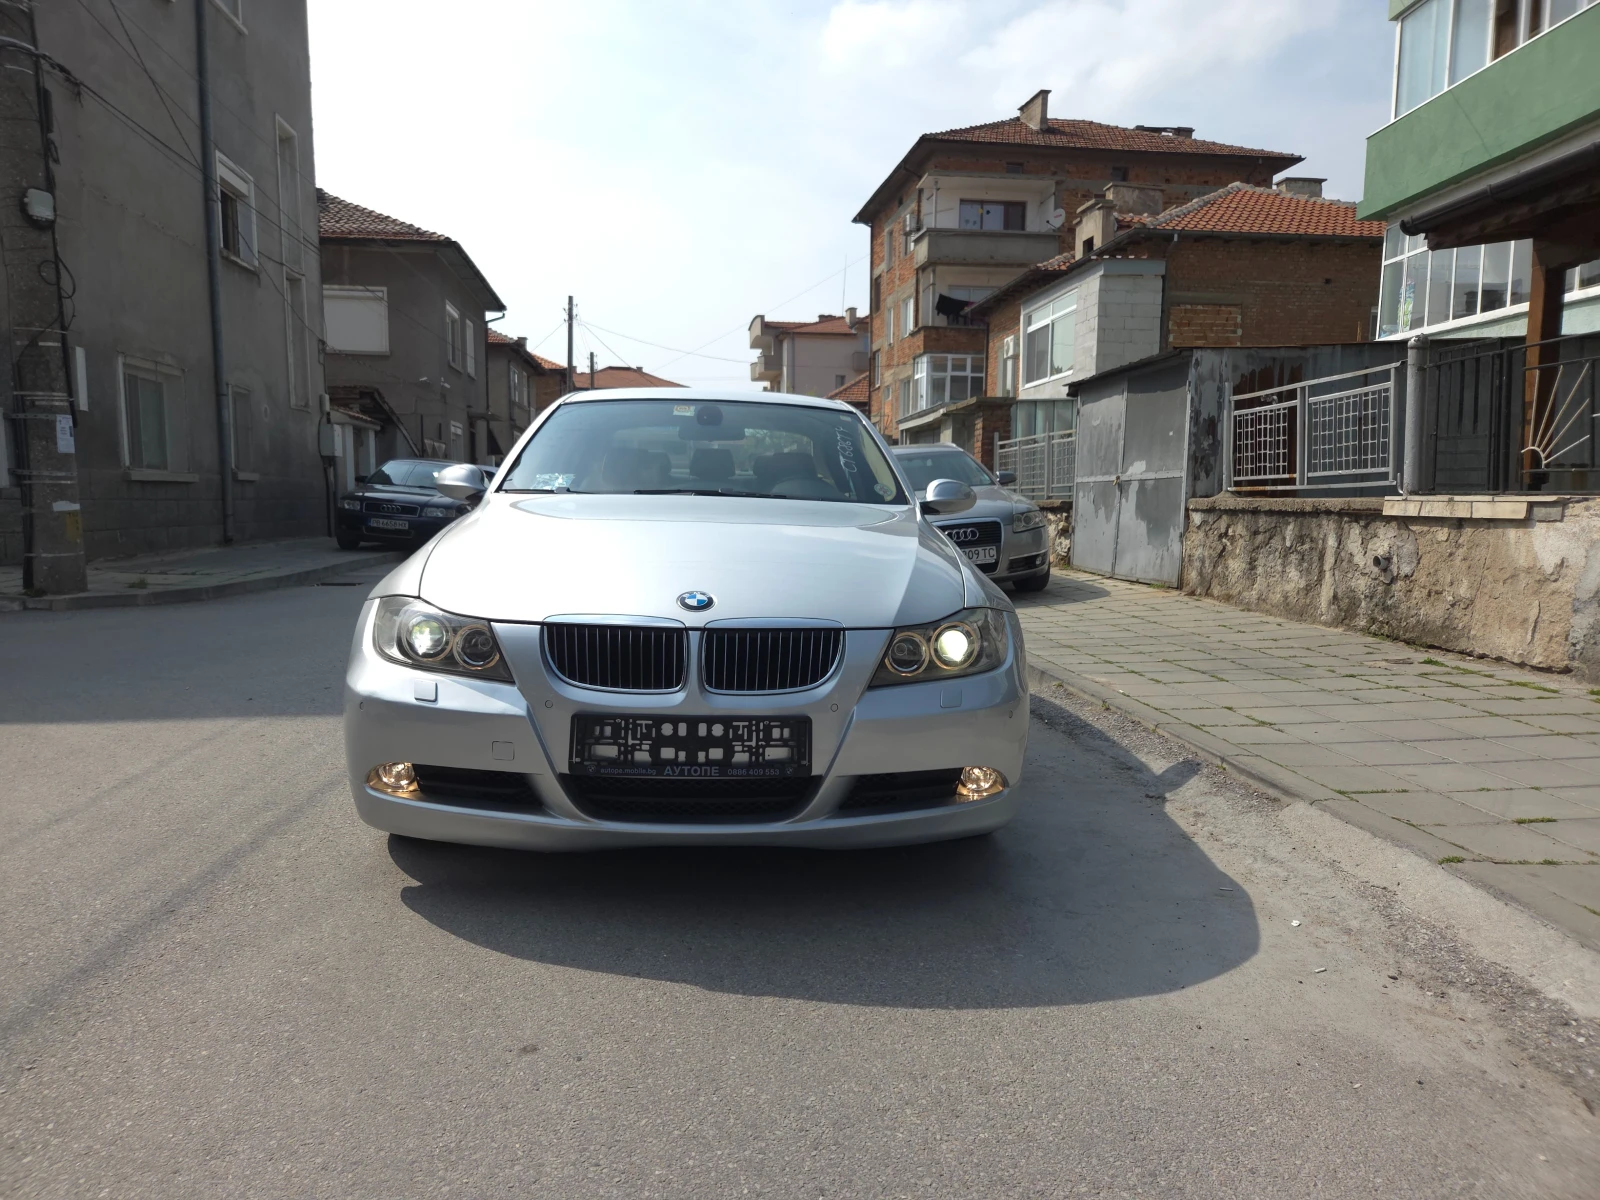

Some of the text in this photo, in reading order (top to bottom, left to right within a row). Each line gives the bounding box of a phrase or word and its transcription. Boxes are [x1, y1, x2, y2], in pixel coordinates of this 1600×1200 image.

[981, 547, 995, 559] TC
[600, 767, 657, 775] autope.mobile.bg
[663, 766, 719, 776] АУТОПЕ
[727, 768, 780, 776] 0886 409 553
